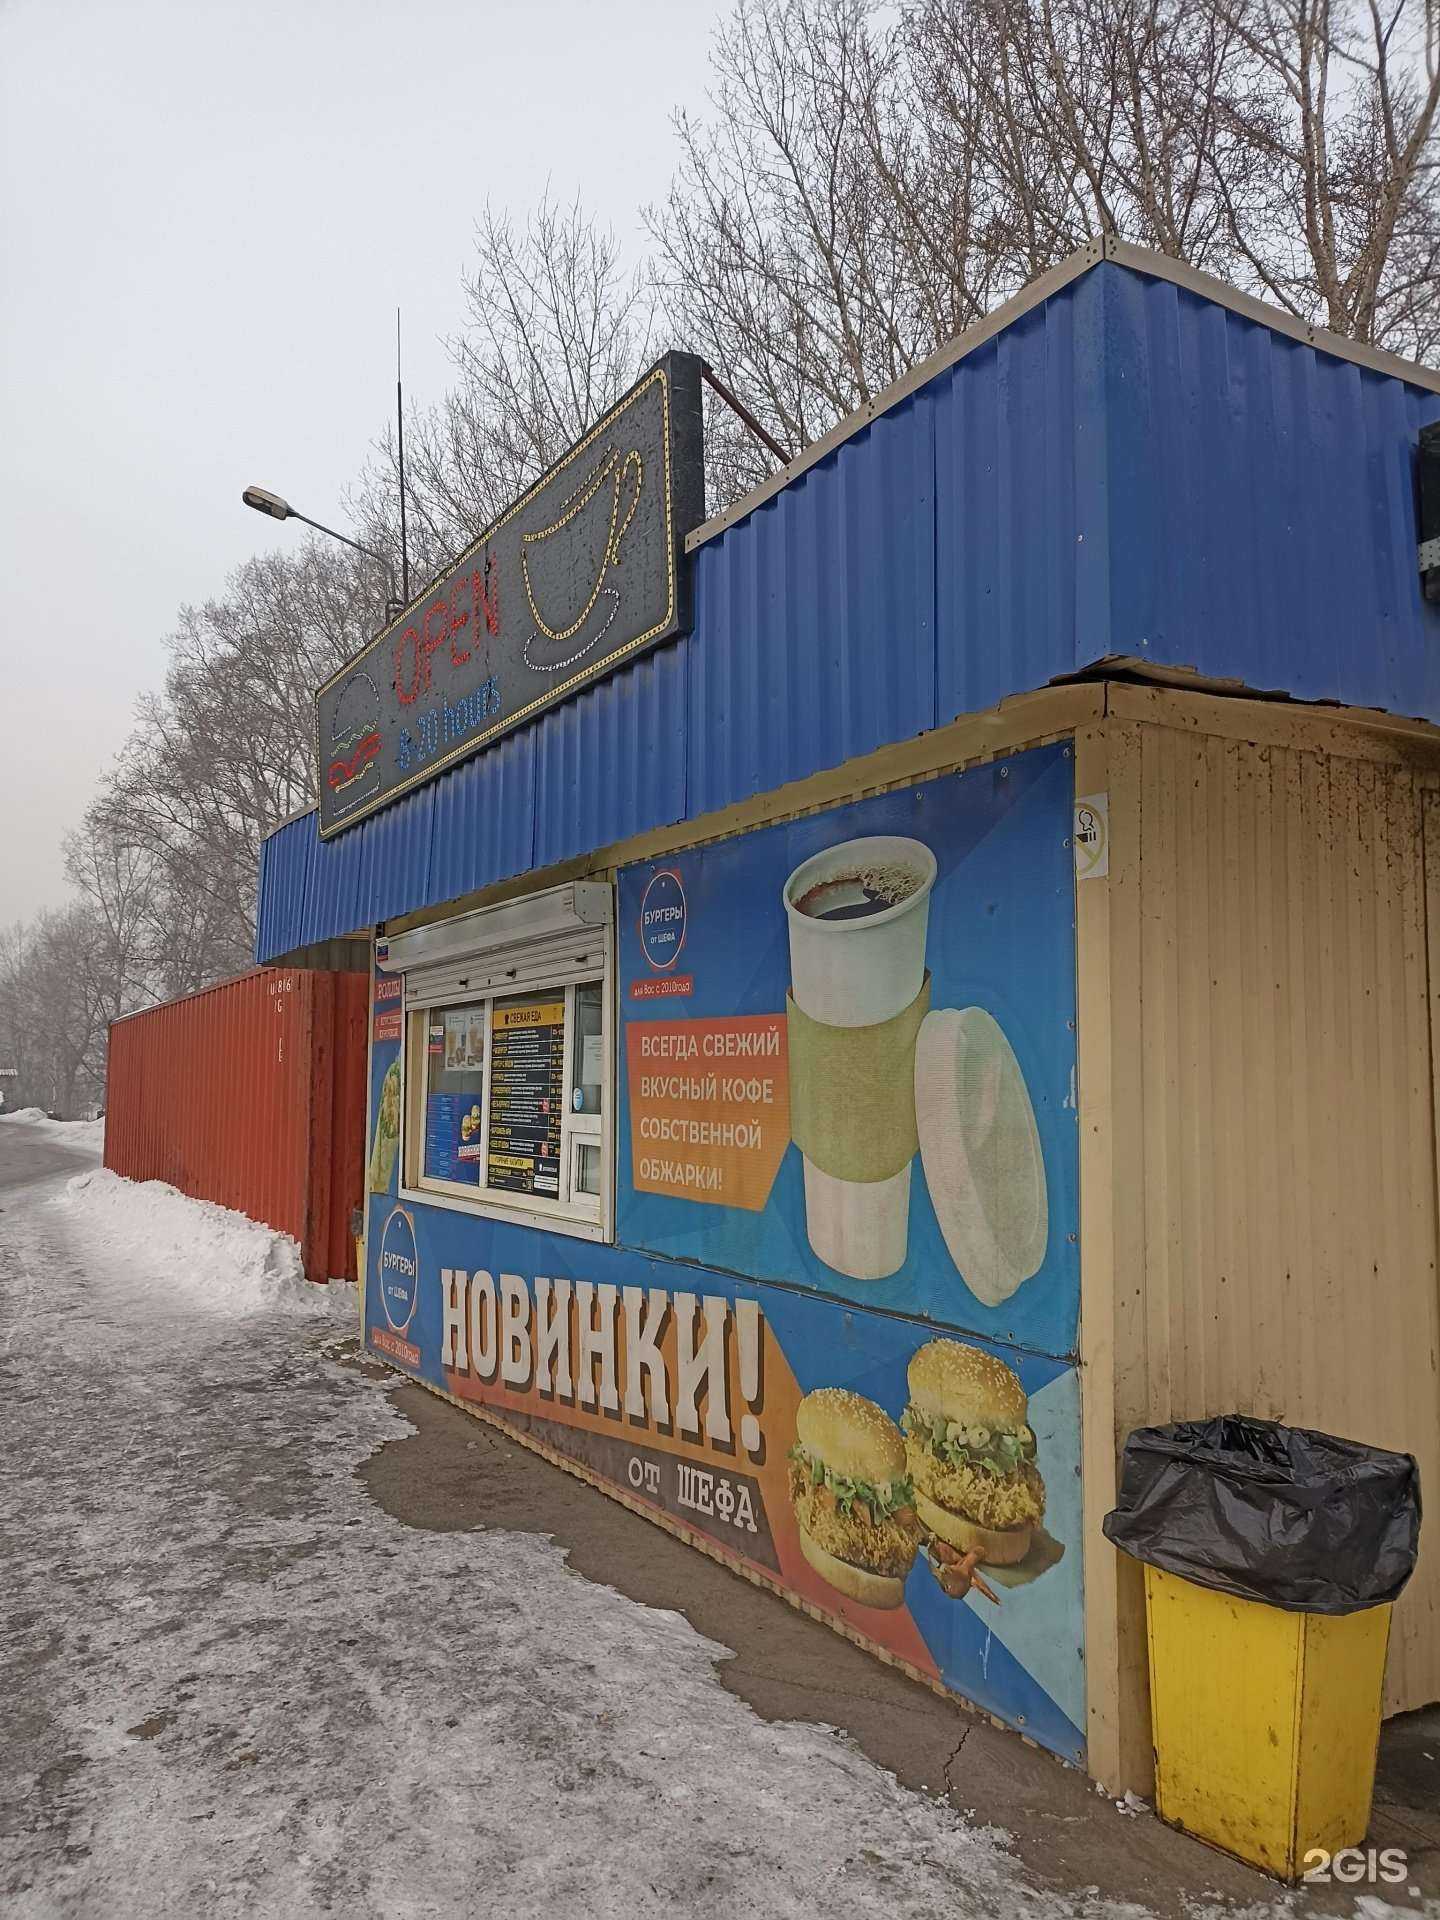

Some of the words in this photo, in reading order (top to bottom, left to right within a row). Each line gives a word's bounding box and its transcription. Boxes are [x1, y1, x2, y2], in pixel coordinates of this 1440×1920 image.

[395, 551, 498, 704] OPEN
[644, 904, 683, 925] БУРГЕРЫ
[531, 1010, 542, 1022] ЕДА
[641, 1031, 699, 1060] ВСЕГДА
[702, 1025, 780, 1058] СВЕЖИЙ
[641, 1072, 717, 1102] ВКУСНЫЙ
[722, 1078, 774, 1104] КОФЕ
[640, 1117, 762, 1150] СОБСТВЕННОЙ
[639, 1157, 723, 1192] ОБЖАРКИ!
[383, 1251, 415, 1276] БУРГЕРЫ
[440, 1268, 763, 1458] НОВИНКИ!
[627, 1456, 662, 1495] ОТ
[677, 1462, 759, 1534] ШЕФА
